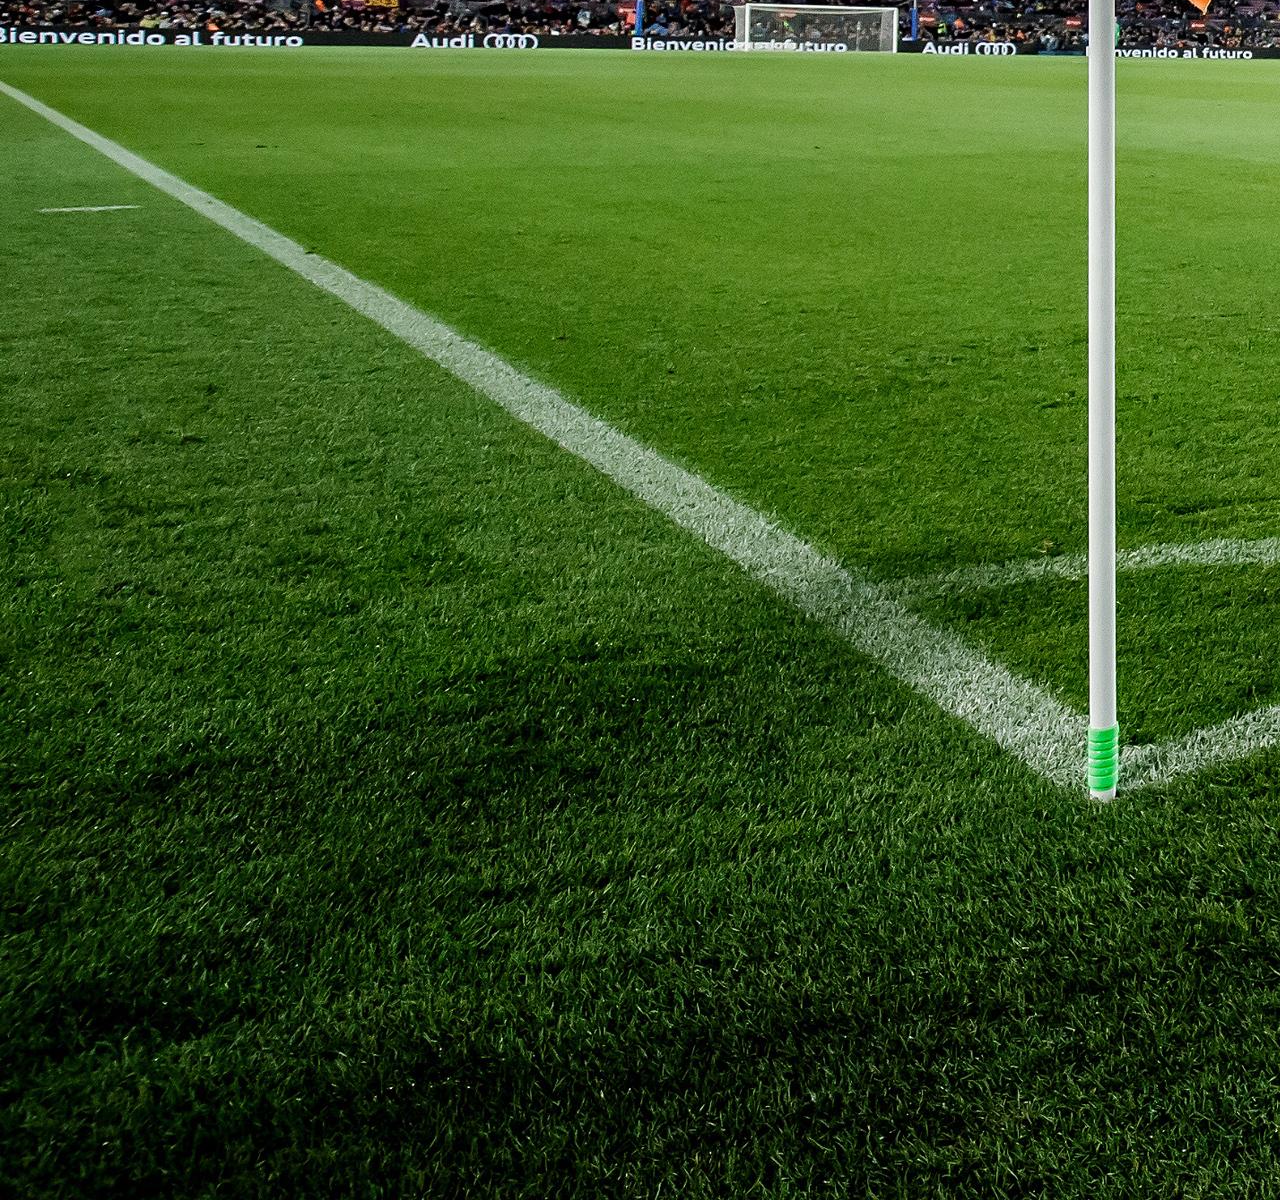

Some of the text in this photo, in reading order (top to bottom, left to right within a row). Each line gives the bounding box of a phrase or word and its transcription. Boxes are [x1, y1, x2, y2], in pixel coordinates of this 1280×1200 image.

[174, 31, 202, 46] al
[210, 31, 304, 47] futuro
[410, 33, 474, 48] Audi
[631, 37, 746, 51] Bienvenid
[922, 42, 969, 55] Audi
[1114, 47, 1253, 60] nvenido al futuro
